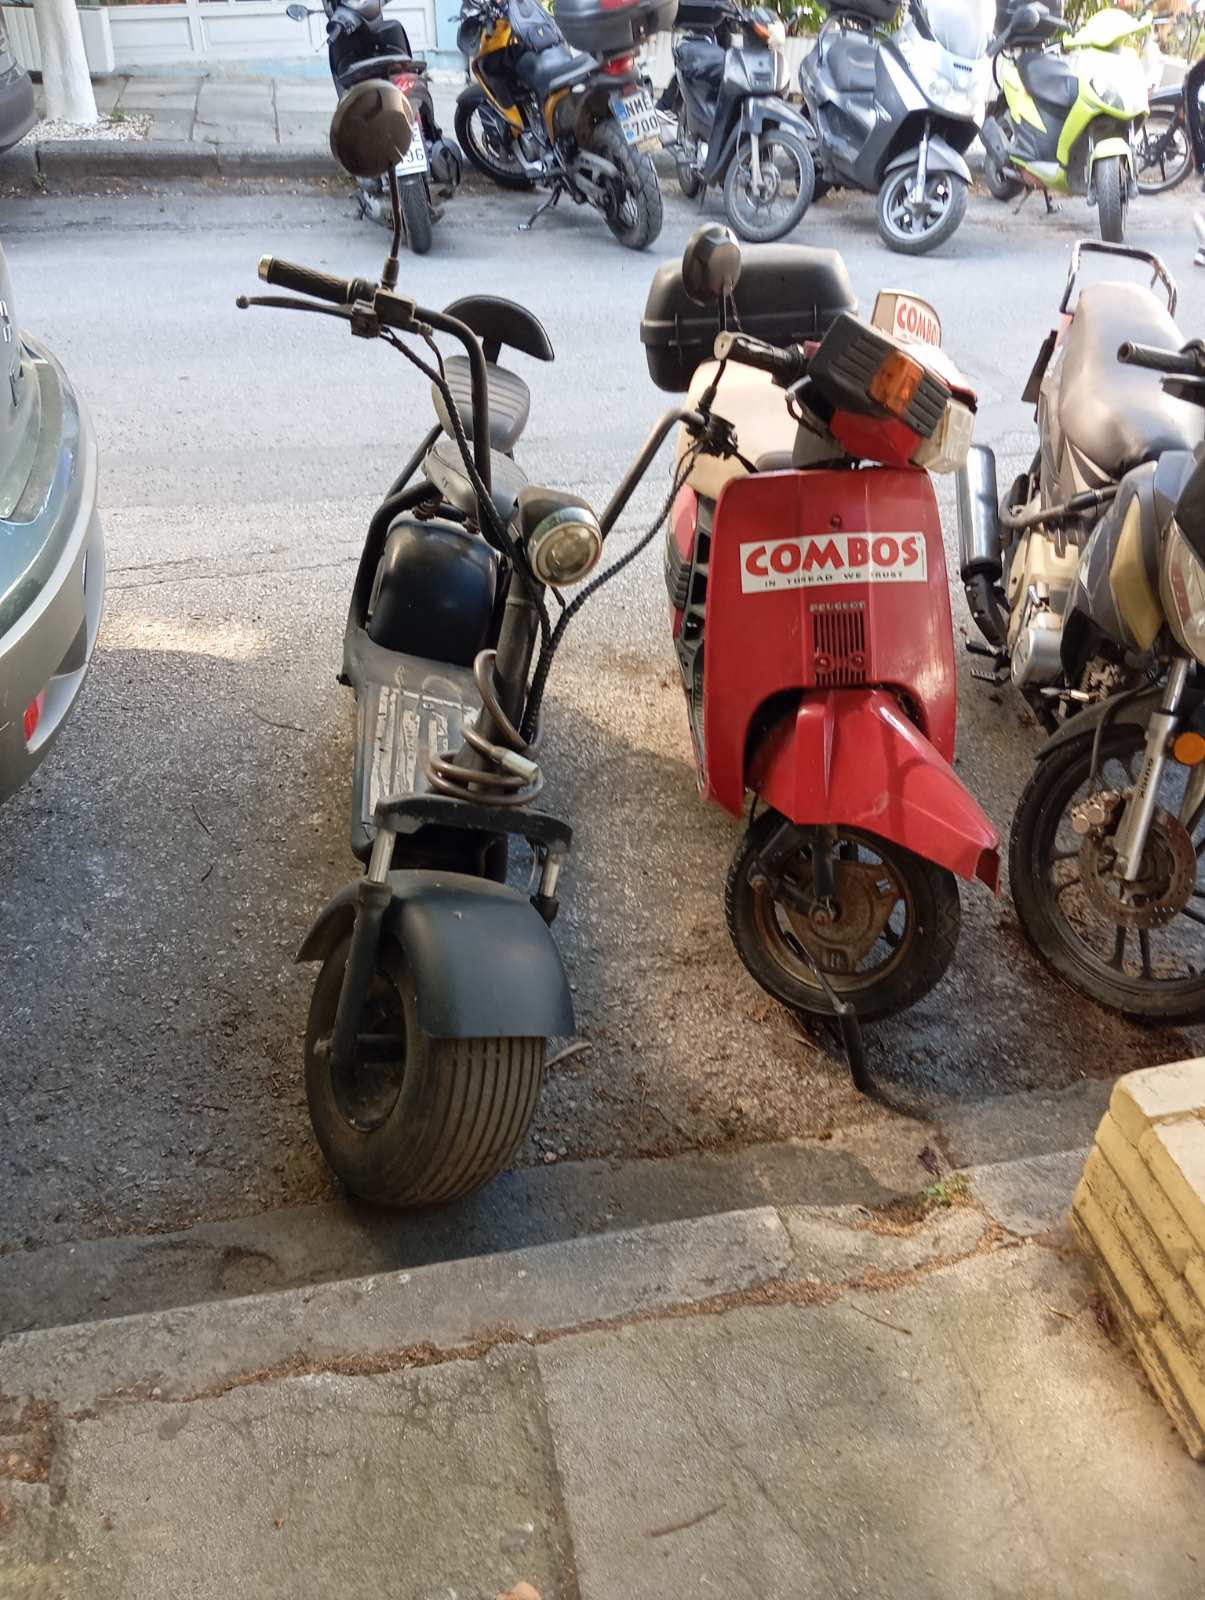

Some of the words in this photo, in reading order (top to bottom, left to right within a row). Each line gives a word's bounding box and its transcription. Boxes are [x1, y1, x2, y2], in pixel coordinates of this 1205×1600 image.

[624, 93, 653, 118] NME
[631, 116, 658, 136] 700
[399, 148, 424, 164] 96
[745, 537, 919, 577] COMBOS
[764, 579, 776, 588] IN
[843, 571, 862, 580] WE
[809, 600, 865, 613] PEUGEOT
